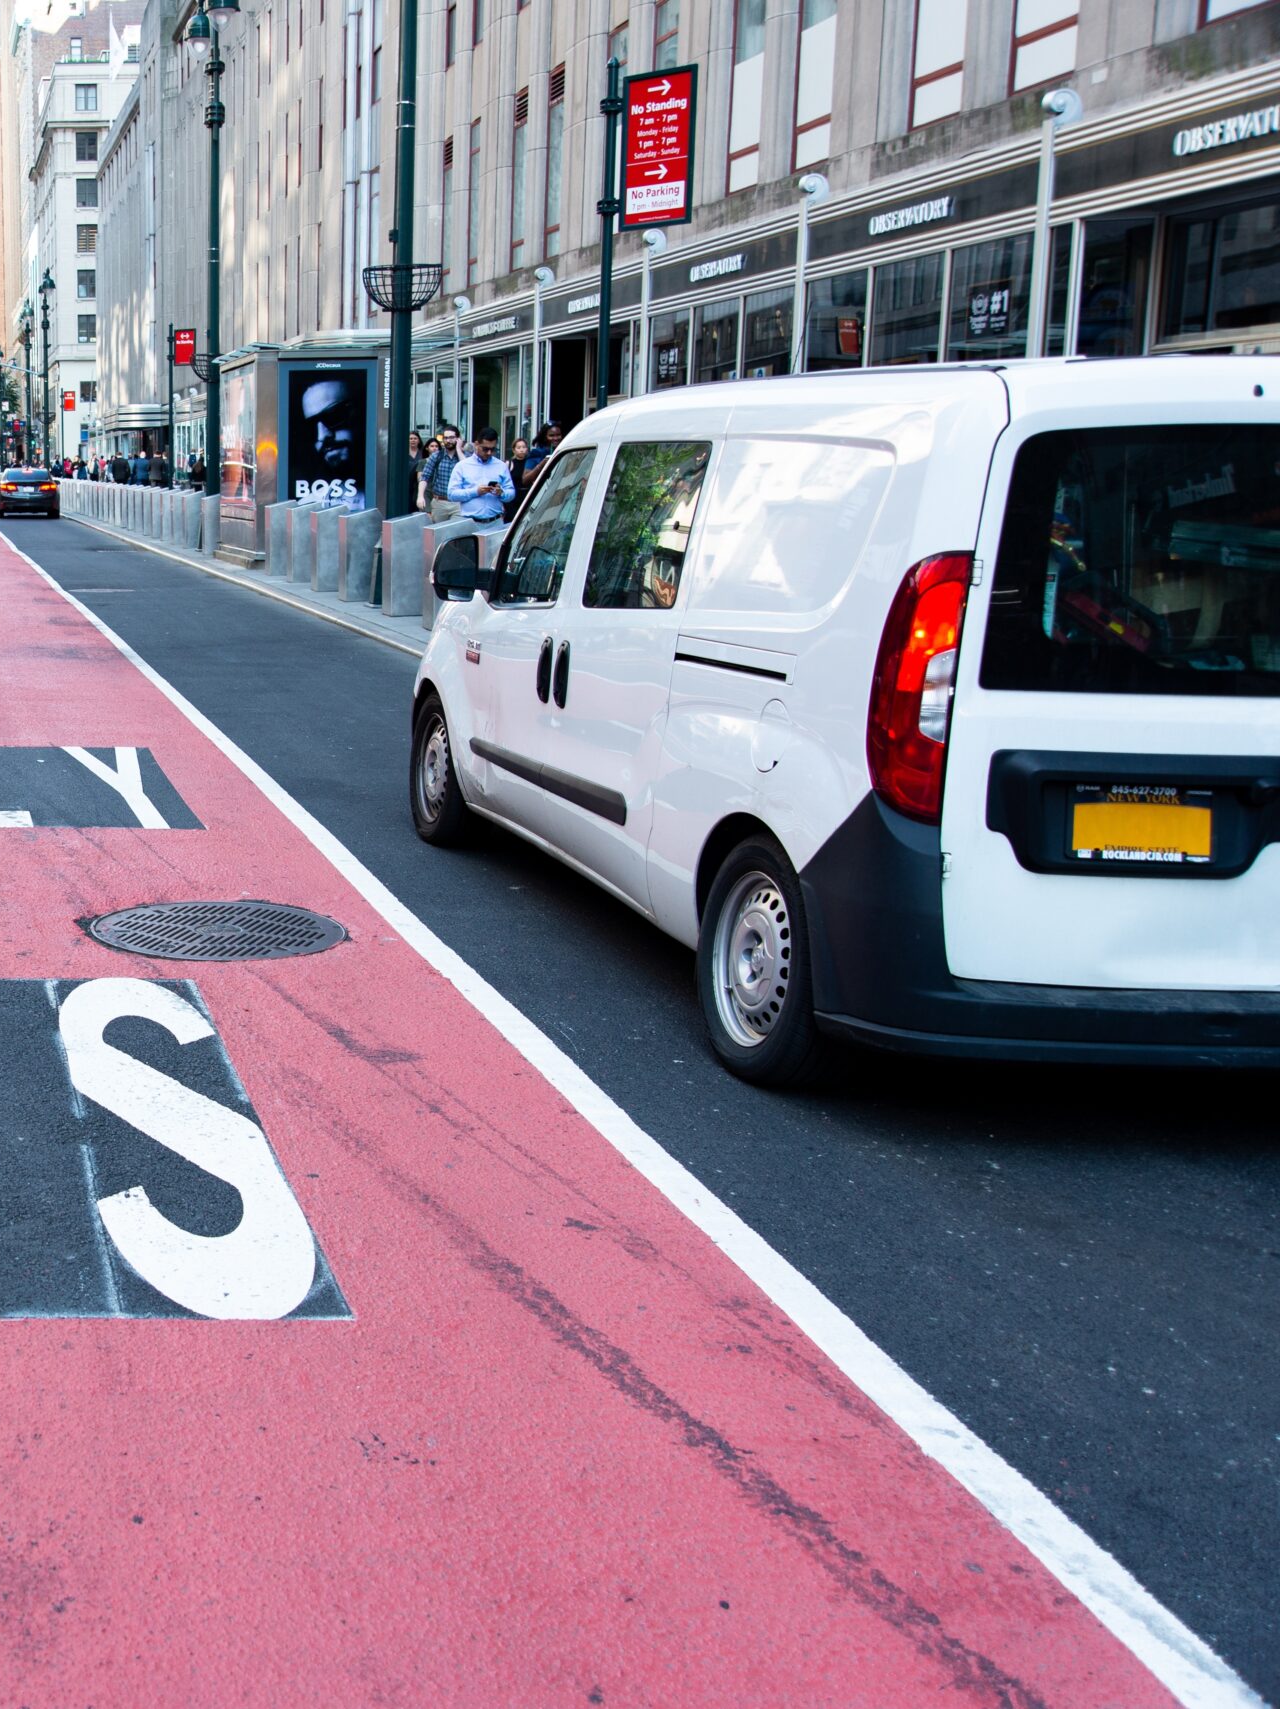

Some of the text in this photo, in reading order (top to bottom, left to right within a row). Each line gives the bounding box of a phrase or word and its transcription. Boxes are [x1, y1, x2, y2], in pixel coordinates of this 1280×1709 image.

[631, 98, 688, 115] No Standing
[639, 118, 644, 126] 7
[662, 114, 666, 122] 7
[667, 114, 678, 123] pm
[636, 129, 658, 137] Monday
[1172, 103, 1280, 156] OBSERVAT
[643, 140, 654, 149] pm
[661, 137, 666, 145] 7
[666, 137, 677, 146] pm
[634, 151, 657, 160] Saturday
[661, 147, 680, 156] Sunday
[631, 186, 680, 200] No Parking
[632, 203, 636, 211] 7
[636, 203, 646, 211] pm
[651, 199, 678, 208] Midnight
[869, 196, 950, 236] OBSERVATORY
[295, 478, 358, 498] BOSS
[1111, 785, 1177, 796] 845-627-3700
[1107, 792, 1180, 805] NEW YORK
